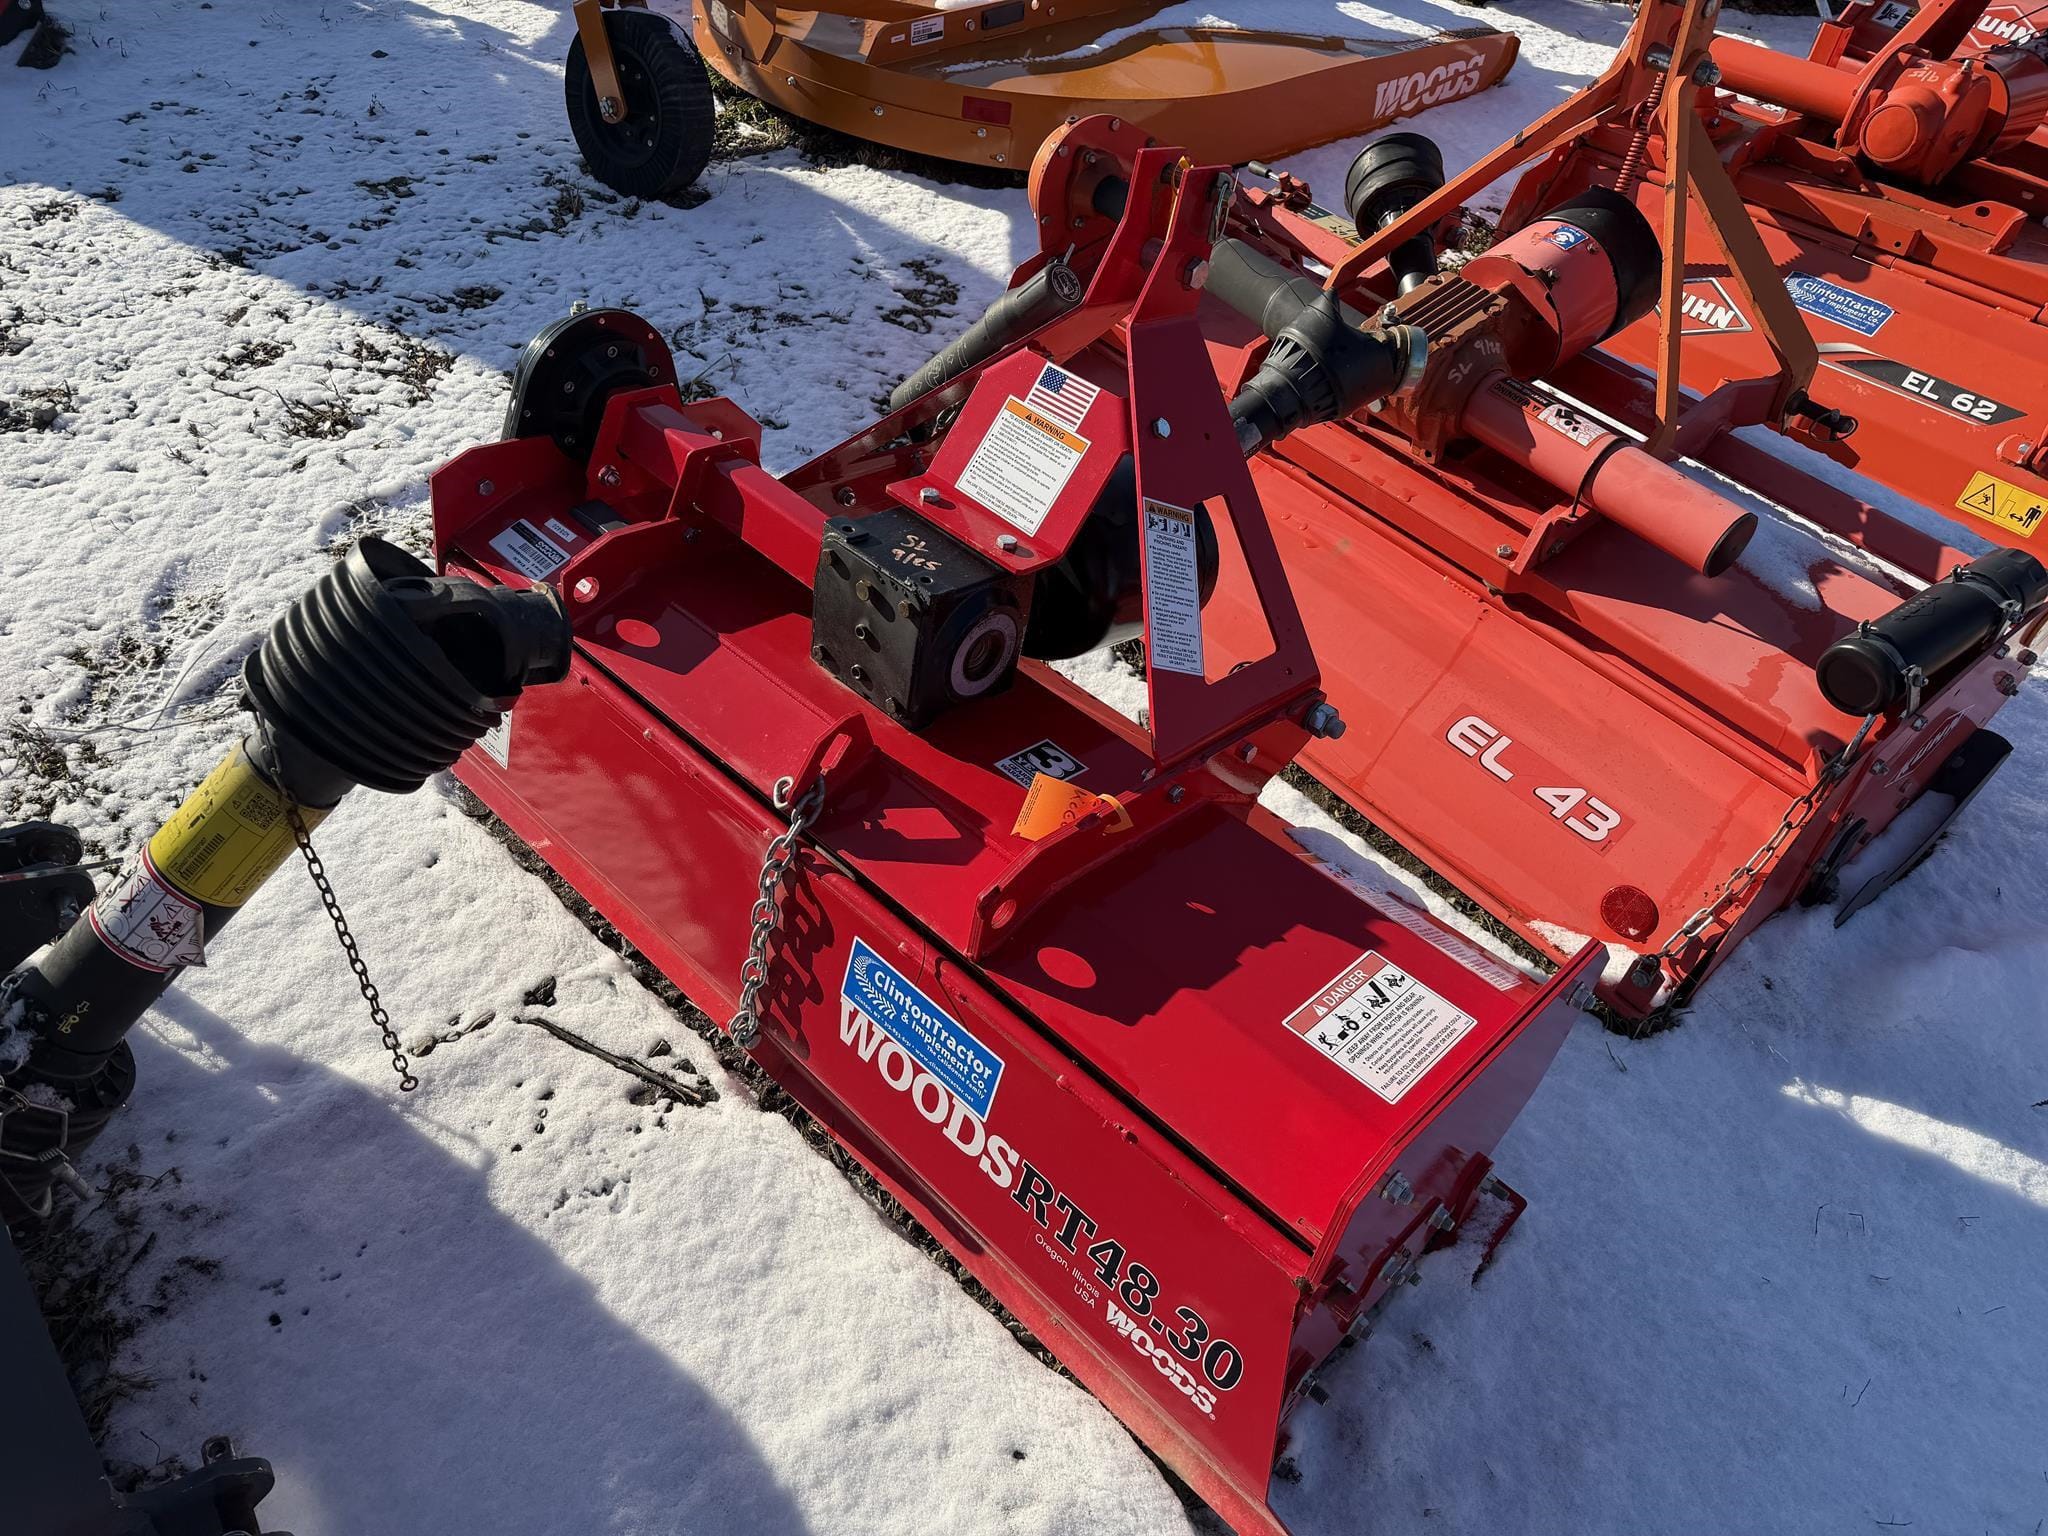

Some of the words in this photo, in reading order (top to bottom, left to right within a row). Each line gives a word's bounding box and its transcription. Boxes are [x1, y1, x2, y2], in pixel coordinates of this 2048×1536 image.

[1973, 13, 2038, 46] UHN
[1374, 53, 1485, 119] WOODS
[1681, 291, 1736, 329] UHN
[1803, 281, 1886, 317] ClintonTractor
[1825, 299, 1866, 319] Implement
[1867, 315, 1880, 323] Co.
[1901, 371, 1940, 401] EL
[1951, 393, 1998, 421] 62
[1032, 417, 1066, 440] WARNING
[1157, 505, 1189, 522] WARNING
[900, 535, 929, 552] SL
[1027, 746, 1076, 777] 3
[1446, 715, 1515, 782] EL
[1533, 786, 1621, 841] 43
[1321, 968, 1369, 1007] DANGER
[872, 965, 994, 1083] ClintonTractor
[1344, 1041, 1360, 1055] KEEP
[1355, 1031, 1371, 1044] AWAY
[1367, 1020, 1383, 1034] FROM
[1379, 1008, 1397, 1023] FRONT
[1393, 1000, 1406, 1011] AND
[1401, 991, 1416, 1003] REAR
[1347, 1041, 1372, 1064] OPENINGS
[1368, 1030, 1385, 1044] WHEN
[1381, 1013, 1404, 1033] TRACTOR
[900, 1010, 910, 1025] &
[910, 1018, 969, 1078] Implement
[970, 1071, 989, 1094] Co.
[926, 1044, 936, 1057] The
[839, 997, 1020, 1189] WOODS
[1010, 1159, 1244, 1391] RT48.30
[1035, 1233, 1069, 1271] Oregon,
[1072, 1267, 1100, 1298] Illinois
[1074, 1283, 1096, 1309] USA
[1106, 1299, 1217, 1414] WOODS
